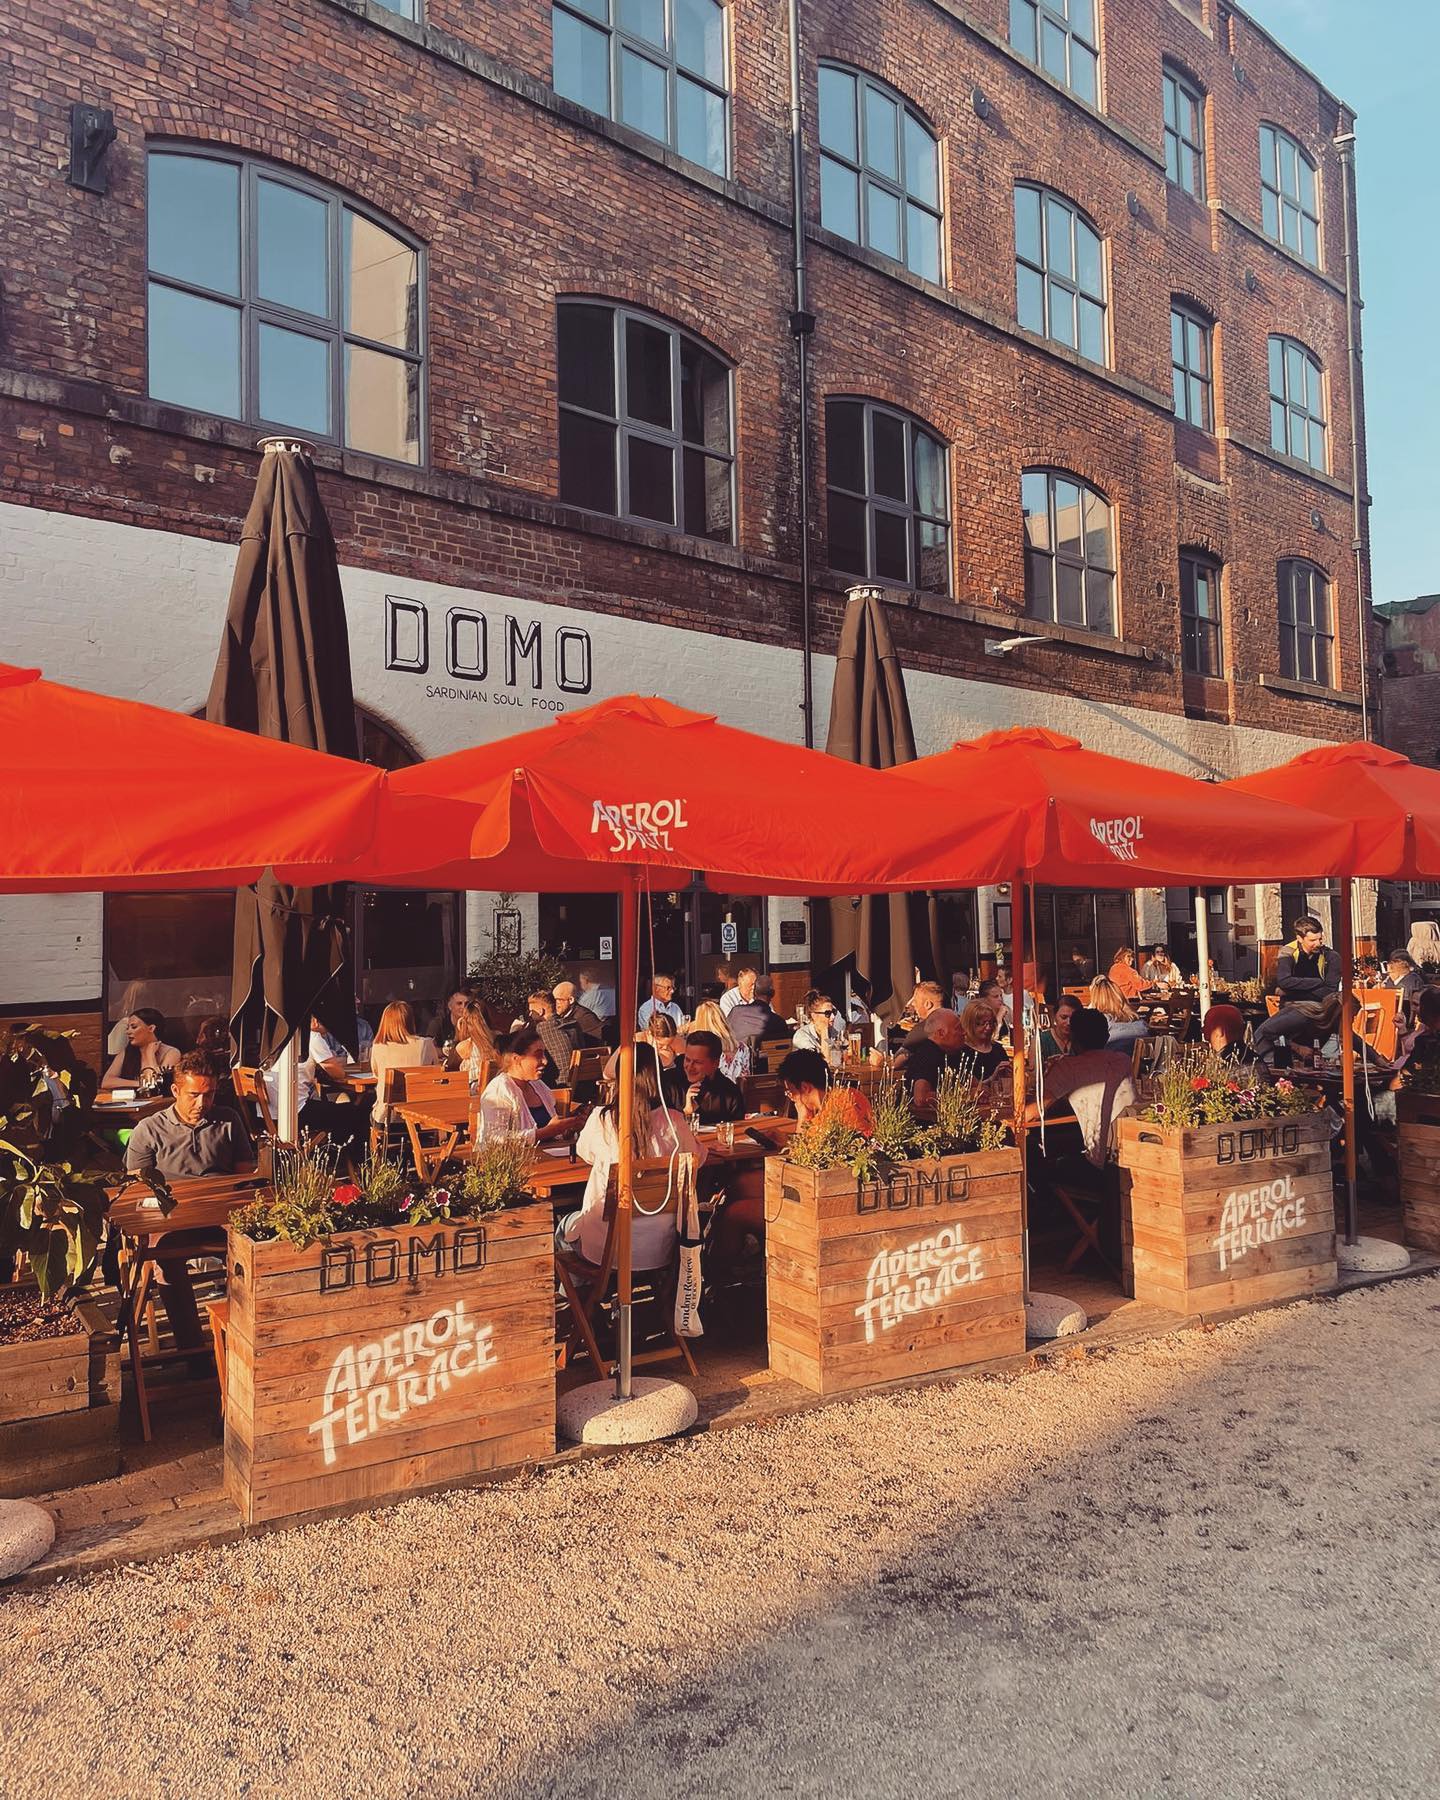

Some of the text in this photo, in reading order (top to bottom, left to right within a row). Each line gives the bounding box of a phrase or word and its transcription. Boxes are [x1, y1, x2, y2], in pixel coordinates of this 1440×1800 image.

[385, 594, 592, 695] DOMO
[426, 685, 565, 712] SARDINIAN SOUL FOOD
[591, 798, 689, 834] APEROL
[1090, 815, 1144, 845] APEROL
[1217, 1124, 1299, 1165] DOMO
[856, 1163, 971, 1216] DOMO
[1220, 1174, 1296, 1234] APEROL
[319, 1226, 487, 1295] DOMO
[865, 1223, 970, 1300] APEROL
[1212, 1196, 1307, 1271] TERRACE
[679, 1257, 694, 1335] London Review
[855, 1246, 985, 1344] TERRACE
[323, 1299, 475, 1414] APEROL
[308, 1324, 498, 1466] TERRACE
